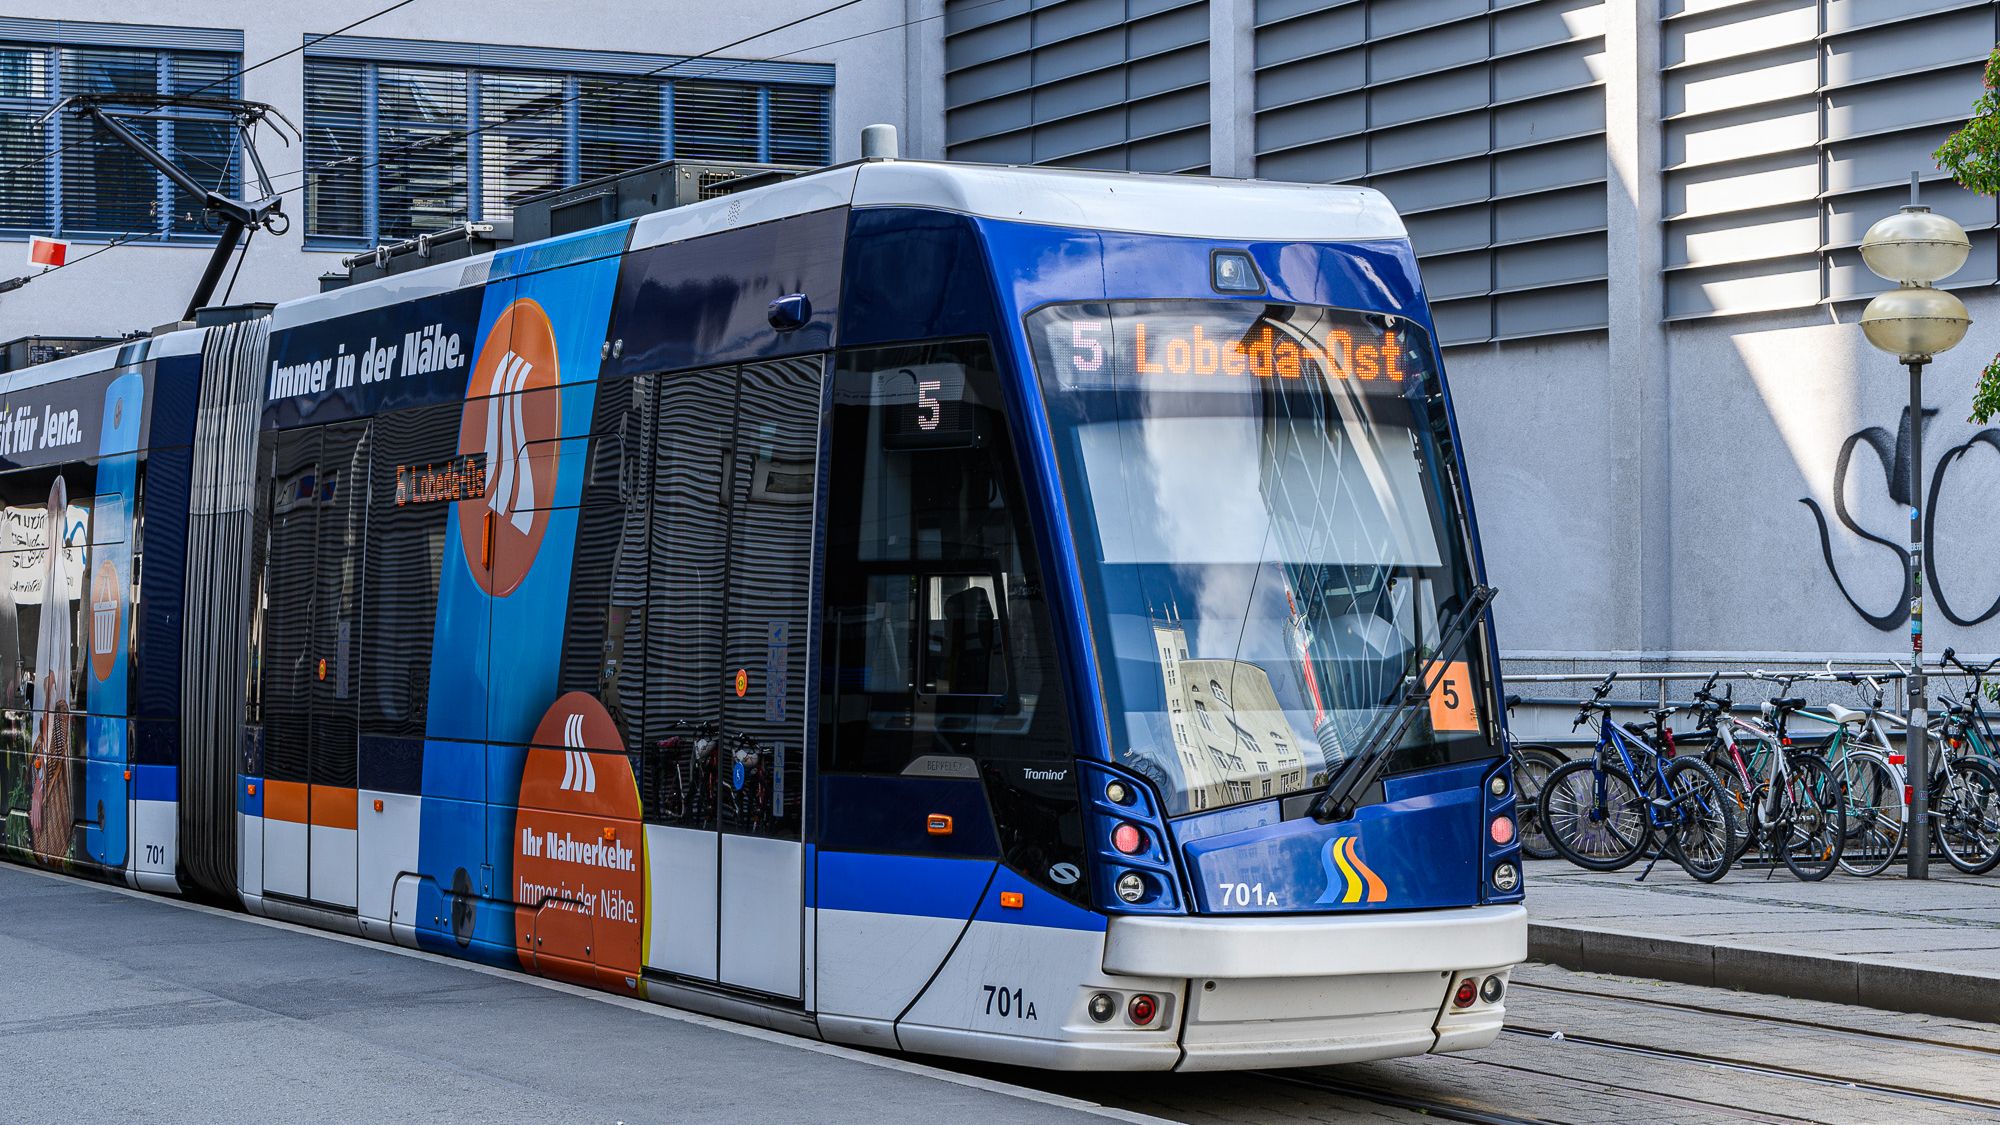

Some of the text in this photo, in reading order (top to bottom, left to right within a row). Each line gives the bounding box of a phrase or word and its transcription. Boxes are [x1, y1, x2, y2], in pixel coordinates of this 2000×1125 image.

[269, 323, 465, 401] Immer in der Nähe.
[1072, 321, 1404, 382] 5 Lobeda-Ost
[13, 405, 39, 454] für
[39, 404, 82, 450] Jena.
[919, 381, 941, 430] 5
[412, 458, 487, 503] Lobeda-Os
[1443, 679, 1460, 710] 5
[1023, 768, 1067, 781] Tramino
[146, 844, 164, 865] 701
[522, 827, 636, 872] Ihr Nahverkehr.
[519, 875, 638, 924] Immer in der Nähe.
